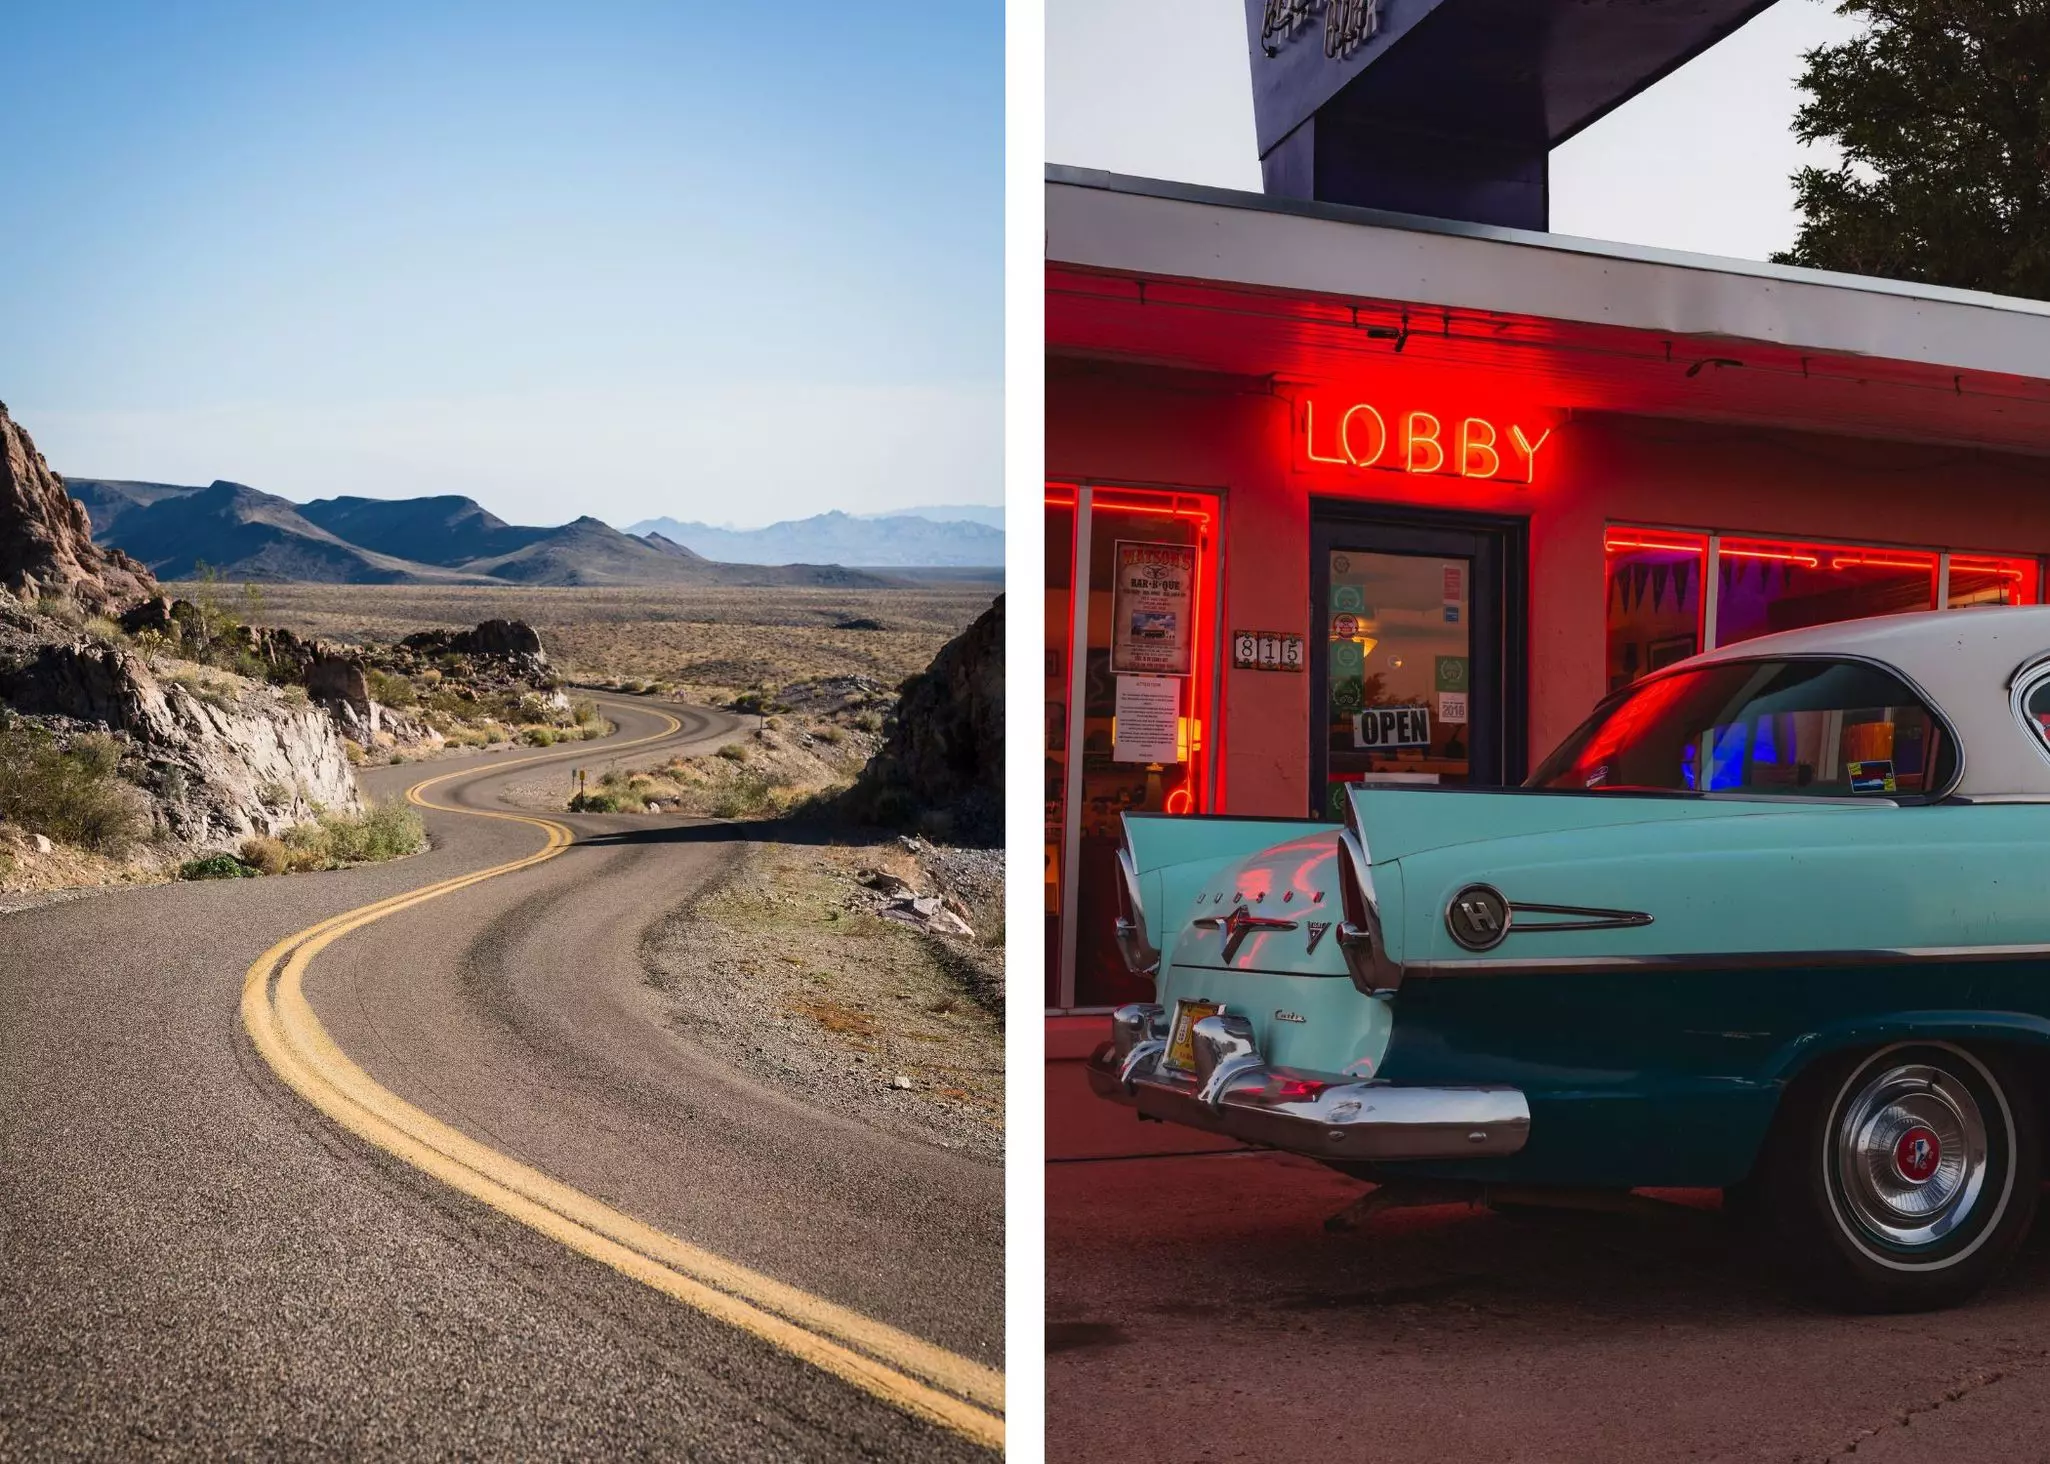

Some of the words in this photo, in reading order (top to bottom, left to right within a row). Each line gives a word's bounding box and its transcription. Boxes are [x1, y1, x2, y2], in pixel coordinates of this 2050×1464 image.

[1306, 400, 1550, 483] LOBBY
[1241, 640, 1298, 661] 815
[1361, 709, 1428, 745] OPEN
